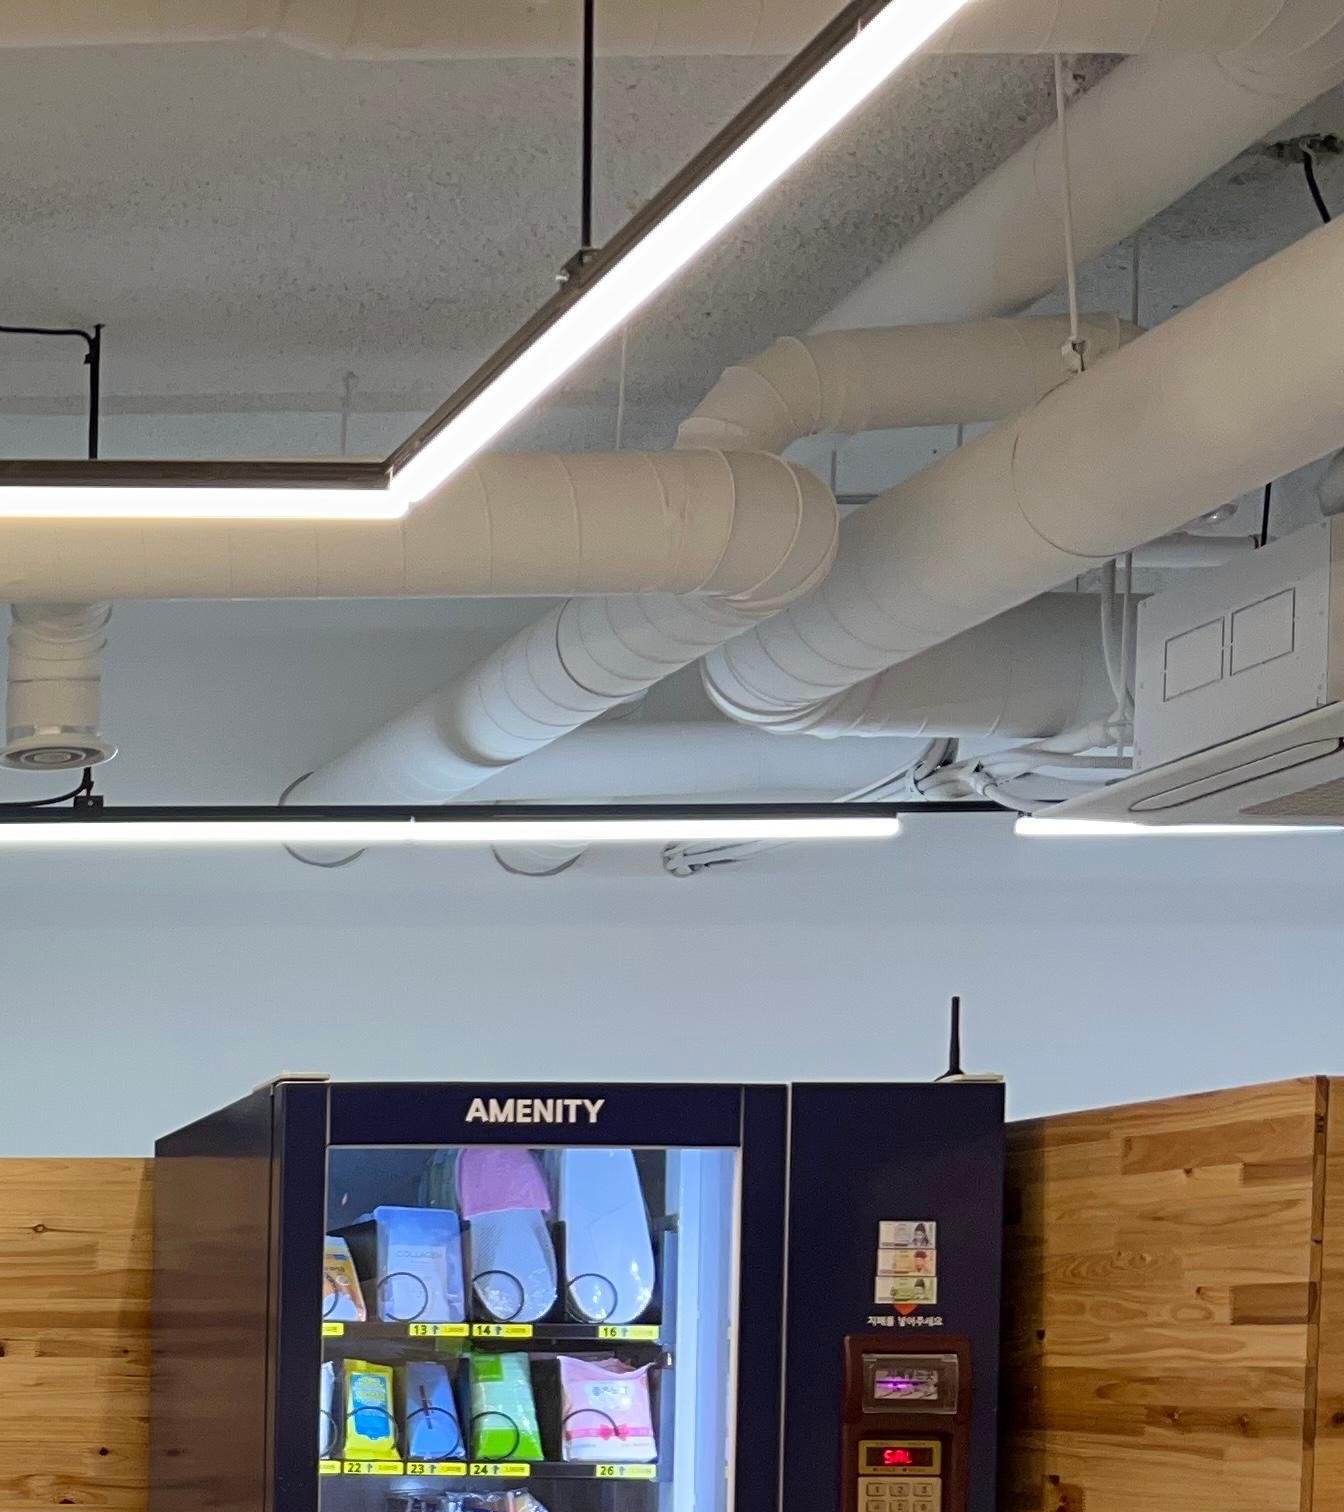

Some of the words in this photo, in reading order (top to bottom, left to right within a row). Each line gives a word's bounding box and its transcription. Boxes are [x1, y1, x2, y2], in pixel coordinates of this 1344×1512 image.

[465, 1098, 605, 1124] AMENITY
[414, 1325, 427, 1335] 13
[478, 1326, 490, 1335] 14
[603, 1327, 617, 1337] 16
[348, 1463, 361, 1473] 22
[412, 1464, 424, 1474] 23
[475, 1465, 488, 1475] 24
[601, 1466, 614, 1477] 26
